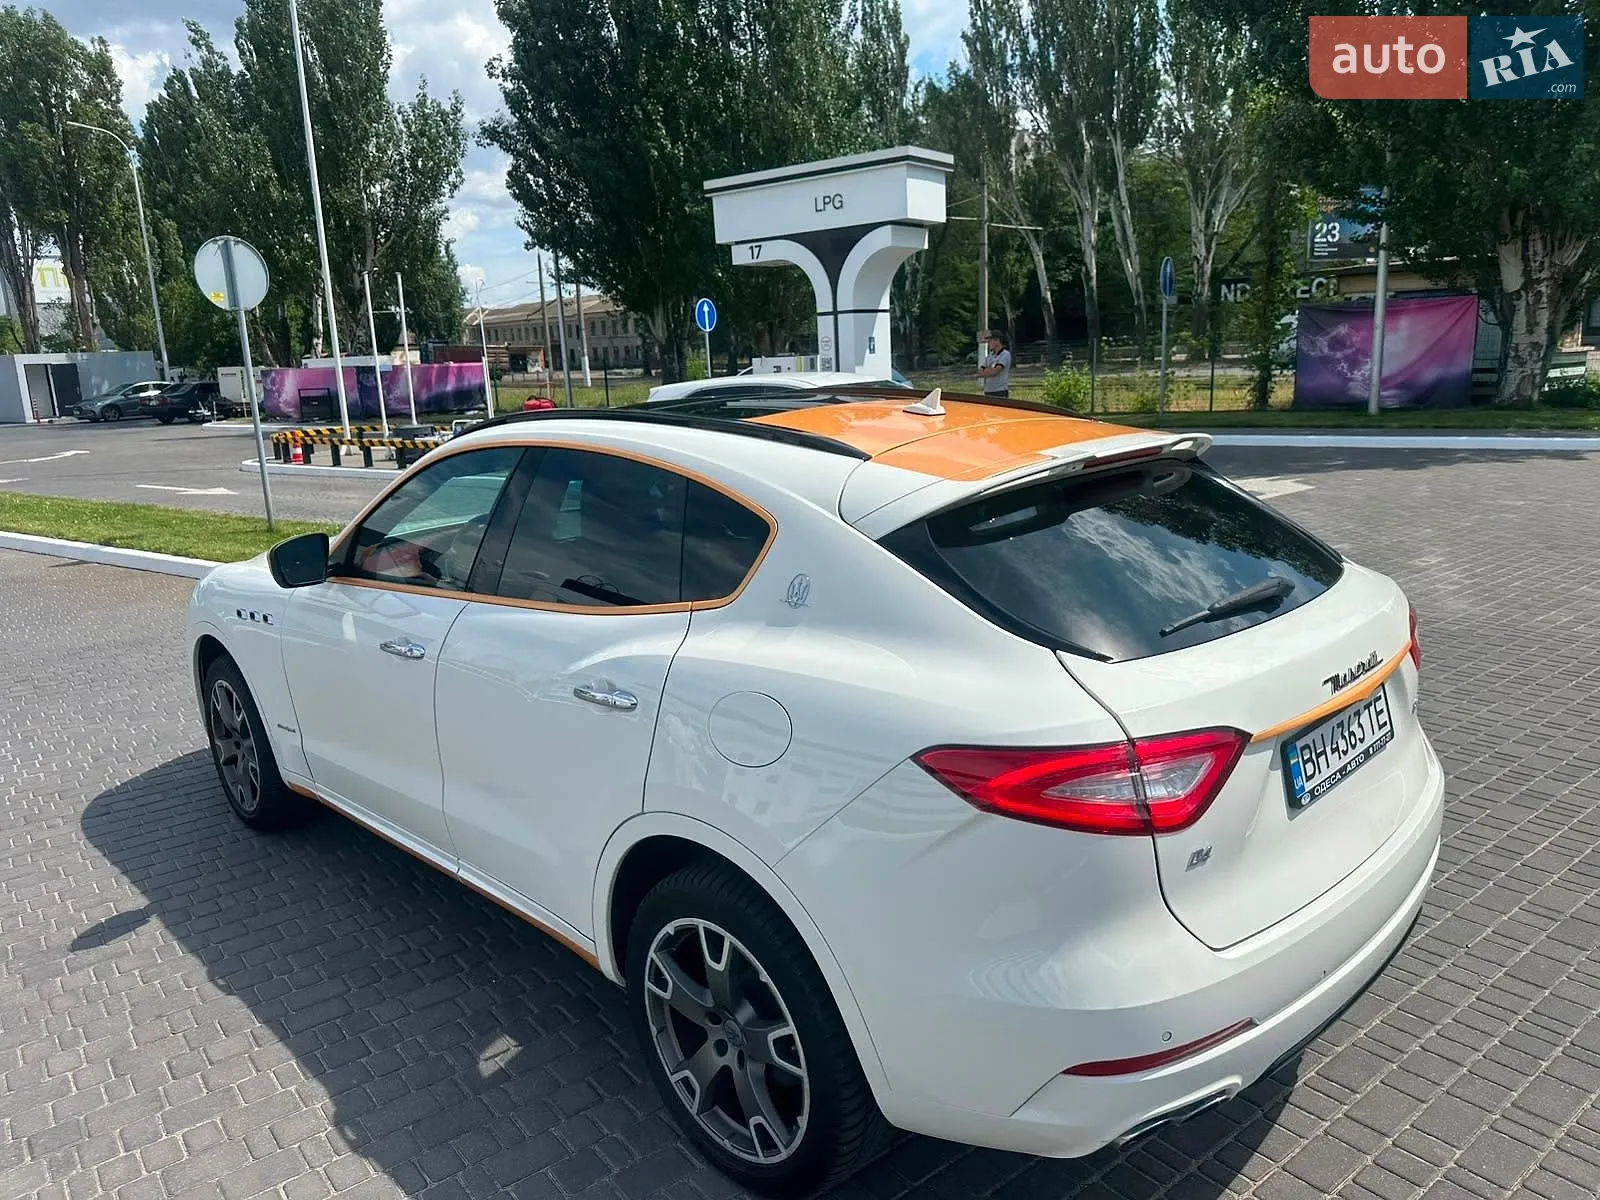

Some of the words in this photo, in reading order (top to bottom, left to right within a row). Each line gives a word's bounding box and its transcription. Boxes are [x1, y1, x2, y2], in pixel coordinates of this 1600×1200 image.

[814, 193, 844, 213] LPG
[1313, 222, 1340, 242] 23
[748, 244, 762, 260] 17
[1300, 733, 1330, 782] BH
[1330, 710, 1366, 760] 4363
[1364, 695, 1388, 736] TE
[1293, 776, 1303, 790] UA
[1314, 773, 1342, 796] ОДЕСА
[1345, 753, 1365, 774] АВТО
